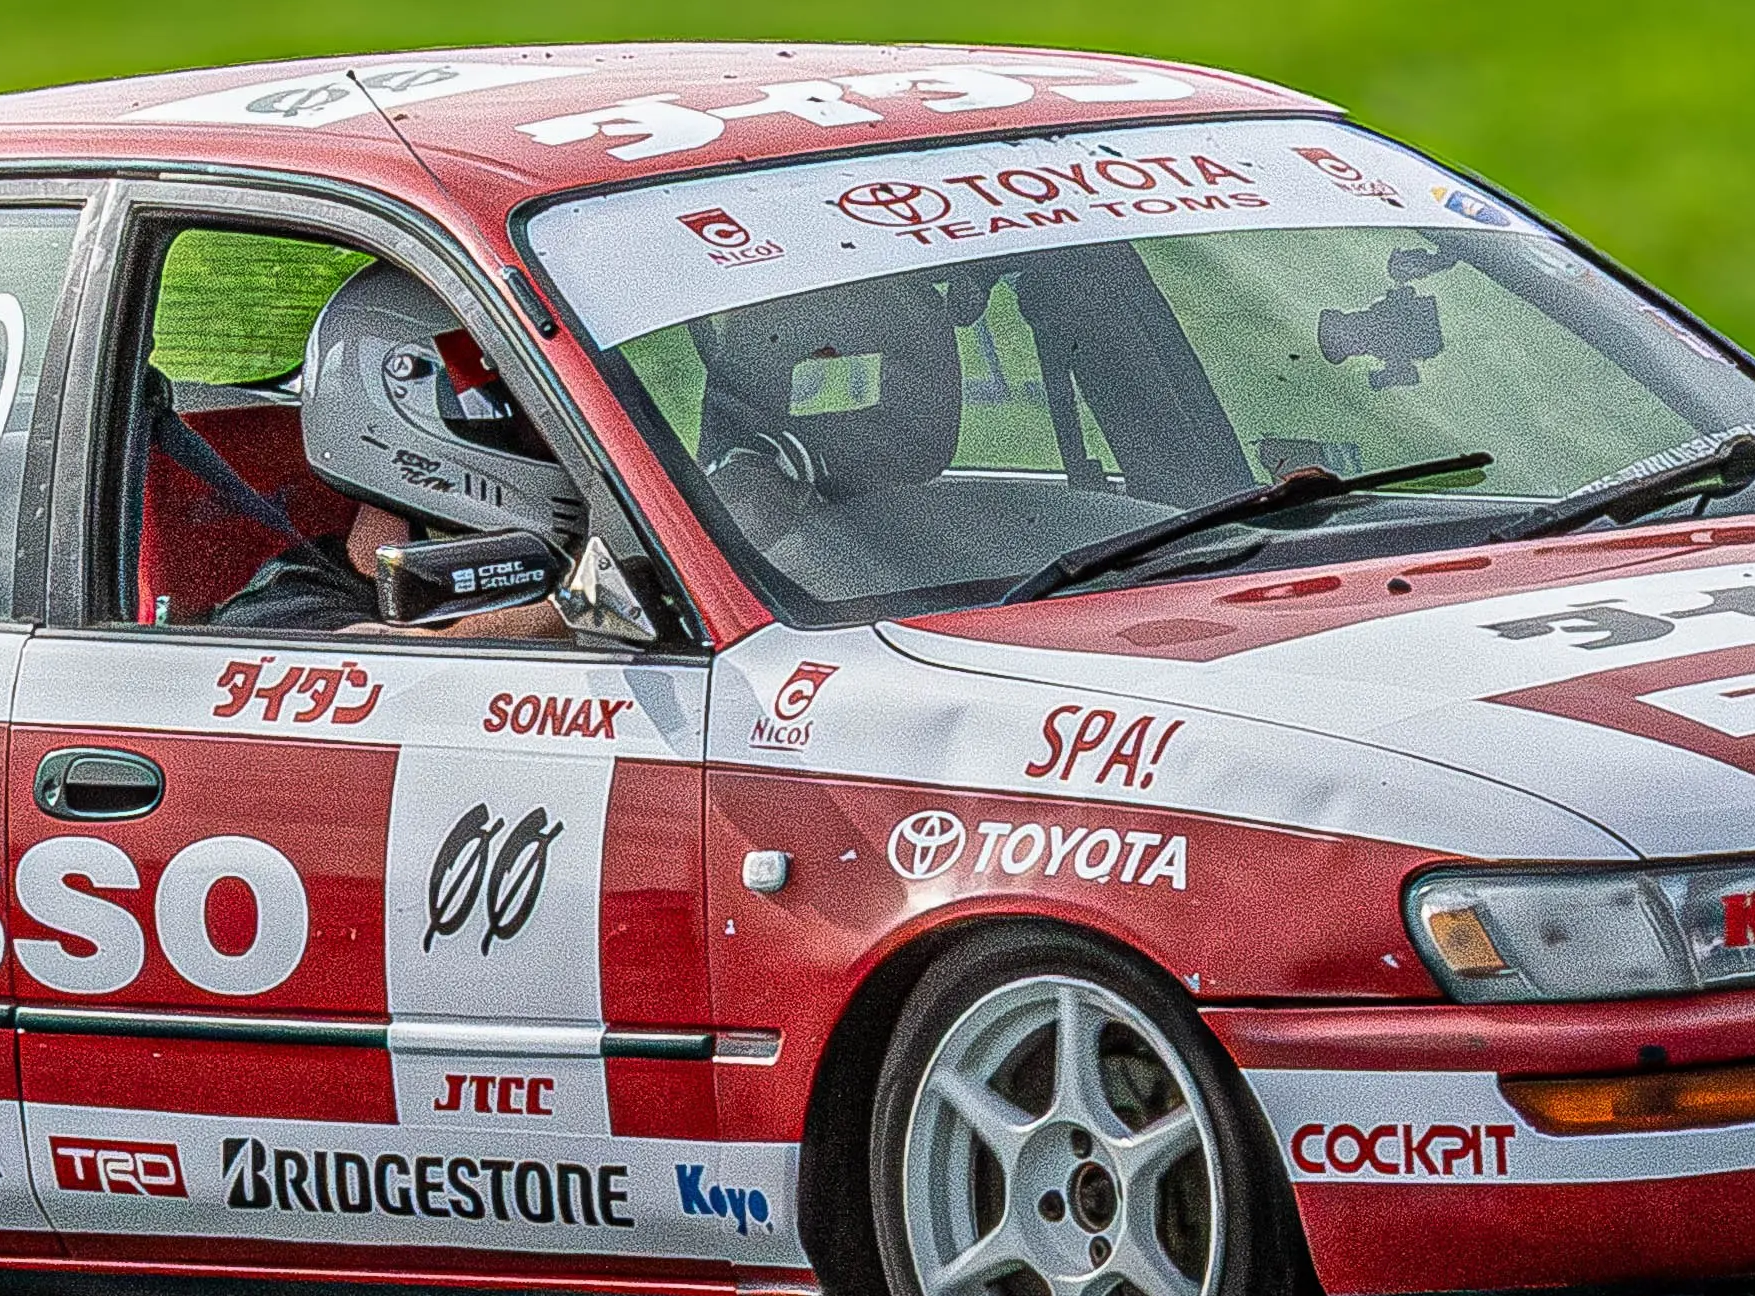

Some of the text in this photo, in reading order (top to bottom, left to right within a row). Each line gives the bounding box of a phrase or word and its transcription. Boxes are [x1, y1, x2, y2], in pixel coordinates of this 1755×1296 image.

[943, 154, 1255, 205] TOYOTA
[895, 192, 1270, 247] TEAM TOMS
[483, 692, 618, 740] SONAX
[1025, 705, 1185, 789] SPA!
[976, 821, 1187, 890] TOYOTA
[433, 1074, 554, 1115] JTCC
[57, 1147, 178, 1196] TRD
[1291, 1124, 1516, 1175] COCKPIT
[221, 1137, 635, 1228] BRIDGESTONE
[675, 1164, 768, 1235] Koyo
